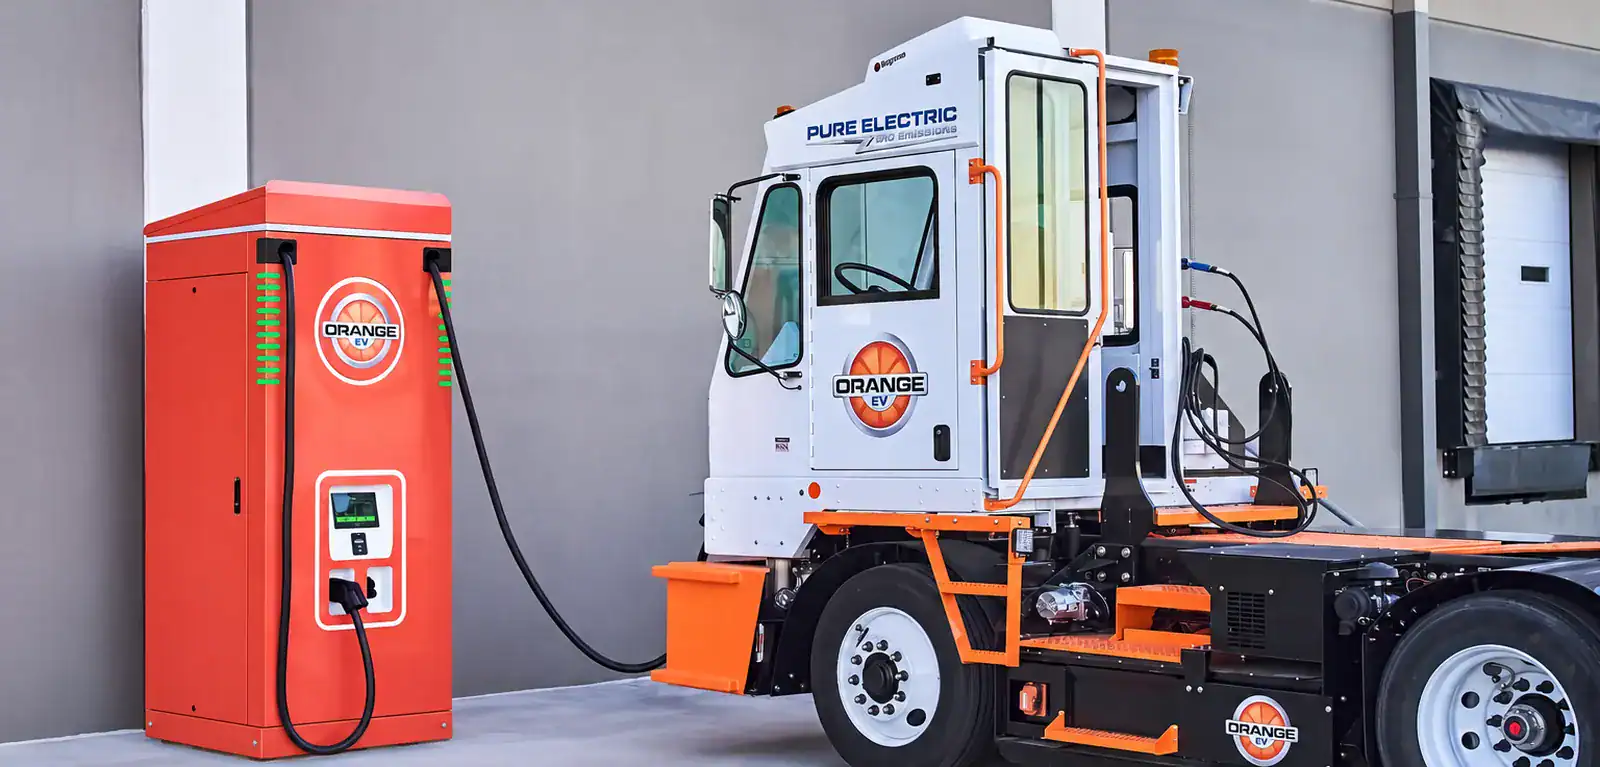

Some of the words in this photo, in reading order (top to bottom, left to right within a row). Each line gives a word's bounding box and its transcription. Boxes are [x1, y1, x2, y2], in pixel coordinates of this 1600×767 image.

[807, 120, 857, 140] PURE
[861, 106, 958, 134] ELECTRIC
[325, 324, 397, 337] ORANGE
[355, 338, 369, 346] EV
[836, 376, 925, 394] ORANGE
[872, 396, 888, 407] EV
[1228, 722, 1296, 740] ORANGE
[1255, 737, 1268, 746] EV
